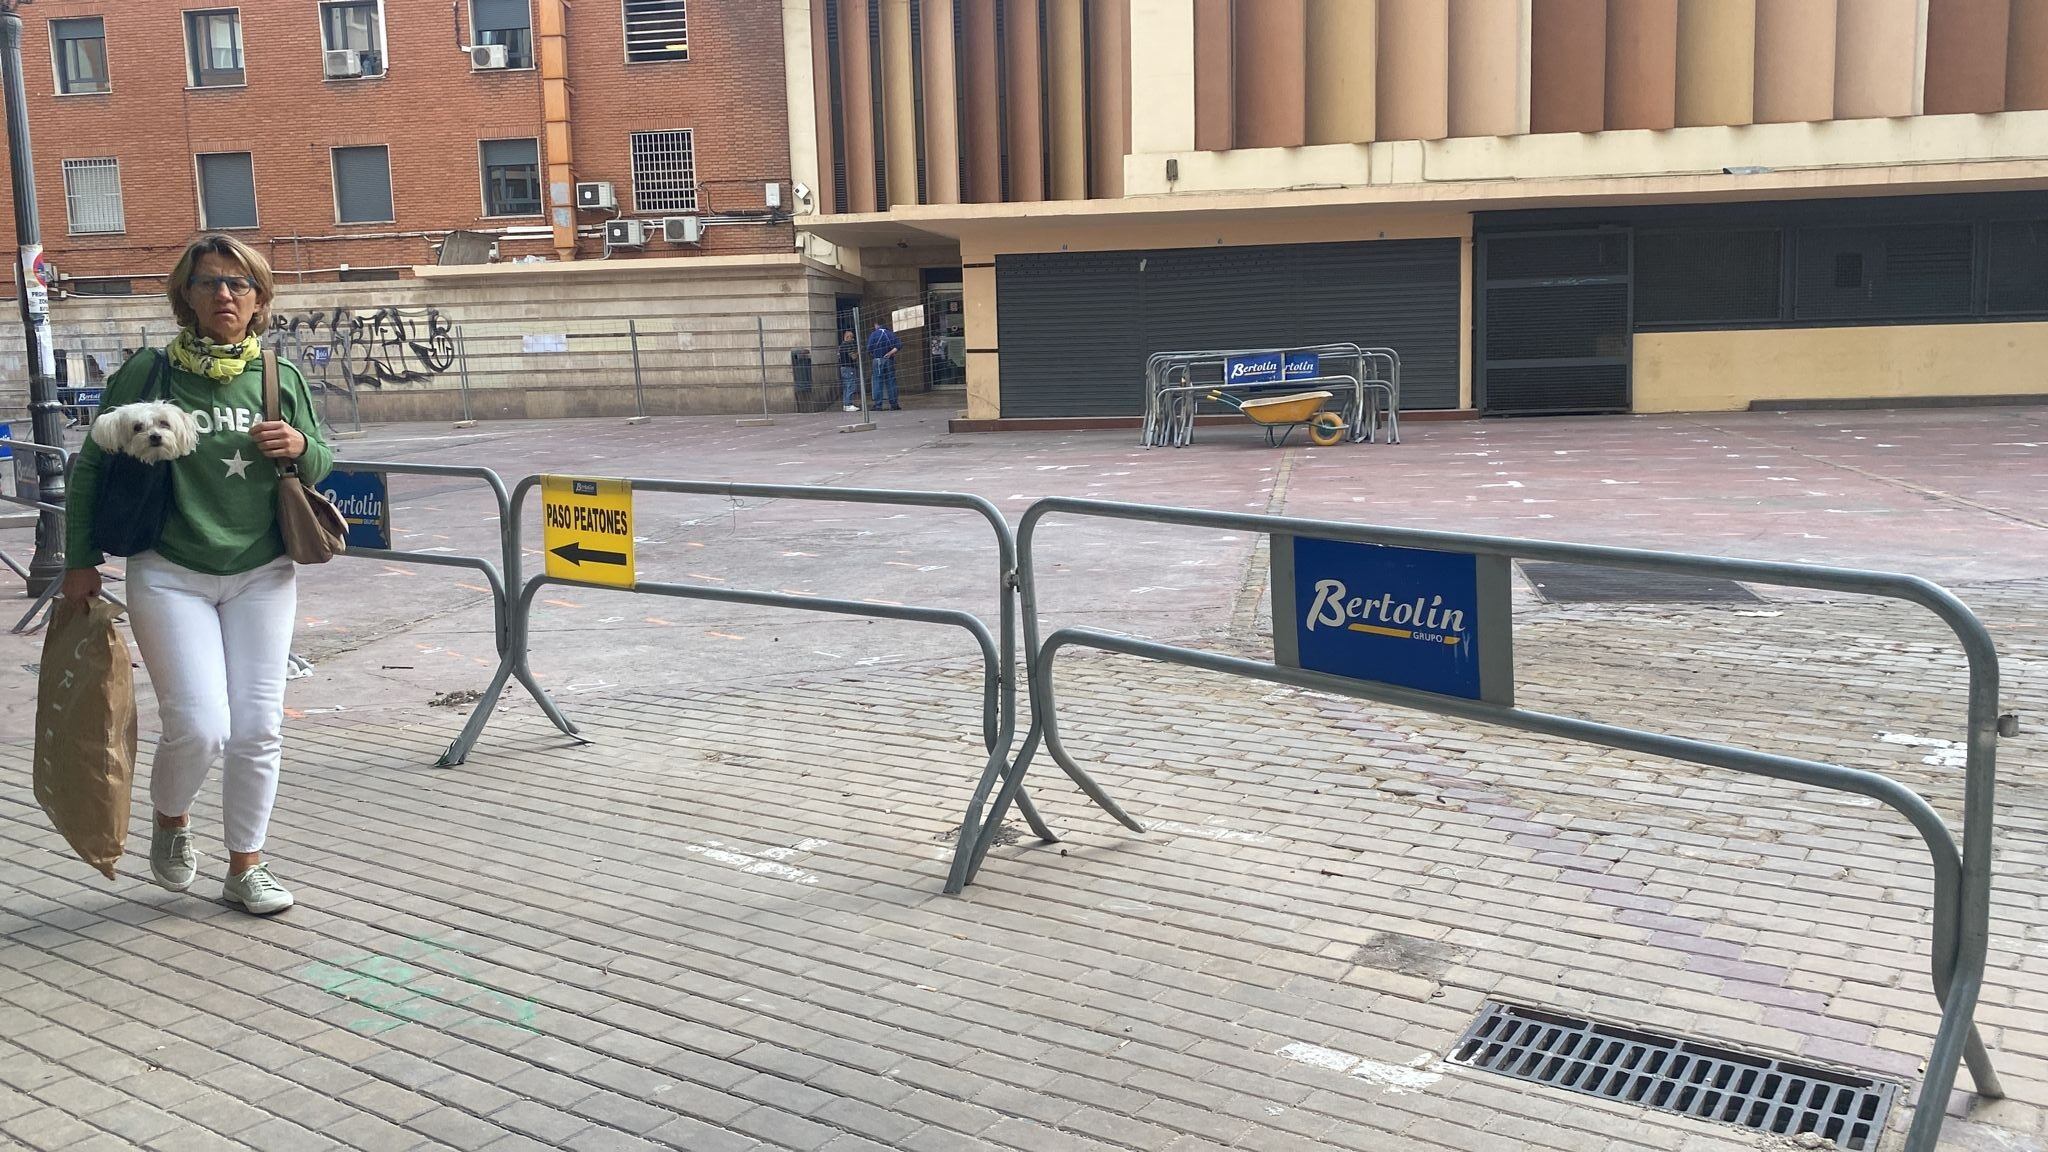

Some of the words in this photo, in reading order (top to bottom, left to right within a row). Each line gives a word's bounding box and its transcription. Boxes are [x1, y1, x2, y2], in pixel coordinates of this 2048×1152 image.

[191, 407, 263, 434] OHE
[546, 503, 571, 529] PASO
[574, 506, 628, 536] PEATONES
[1412, 631, 1443, 643] GRUPO
